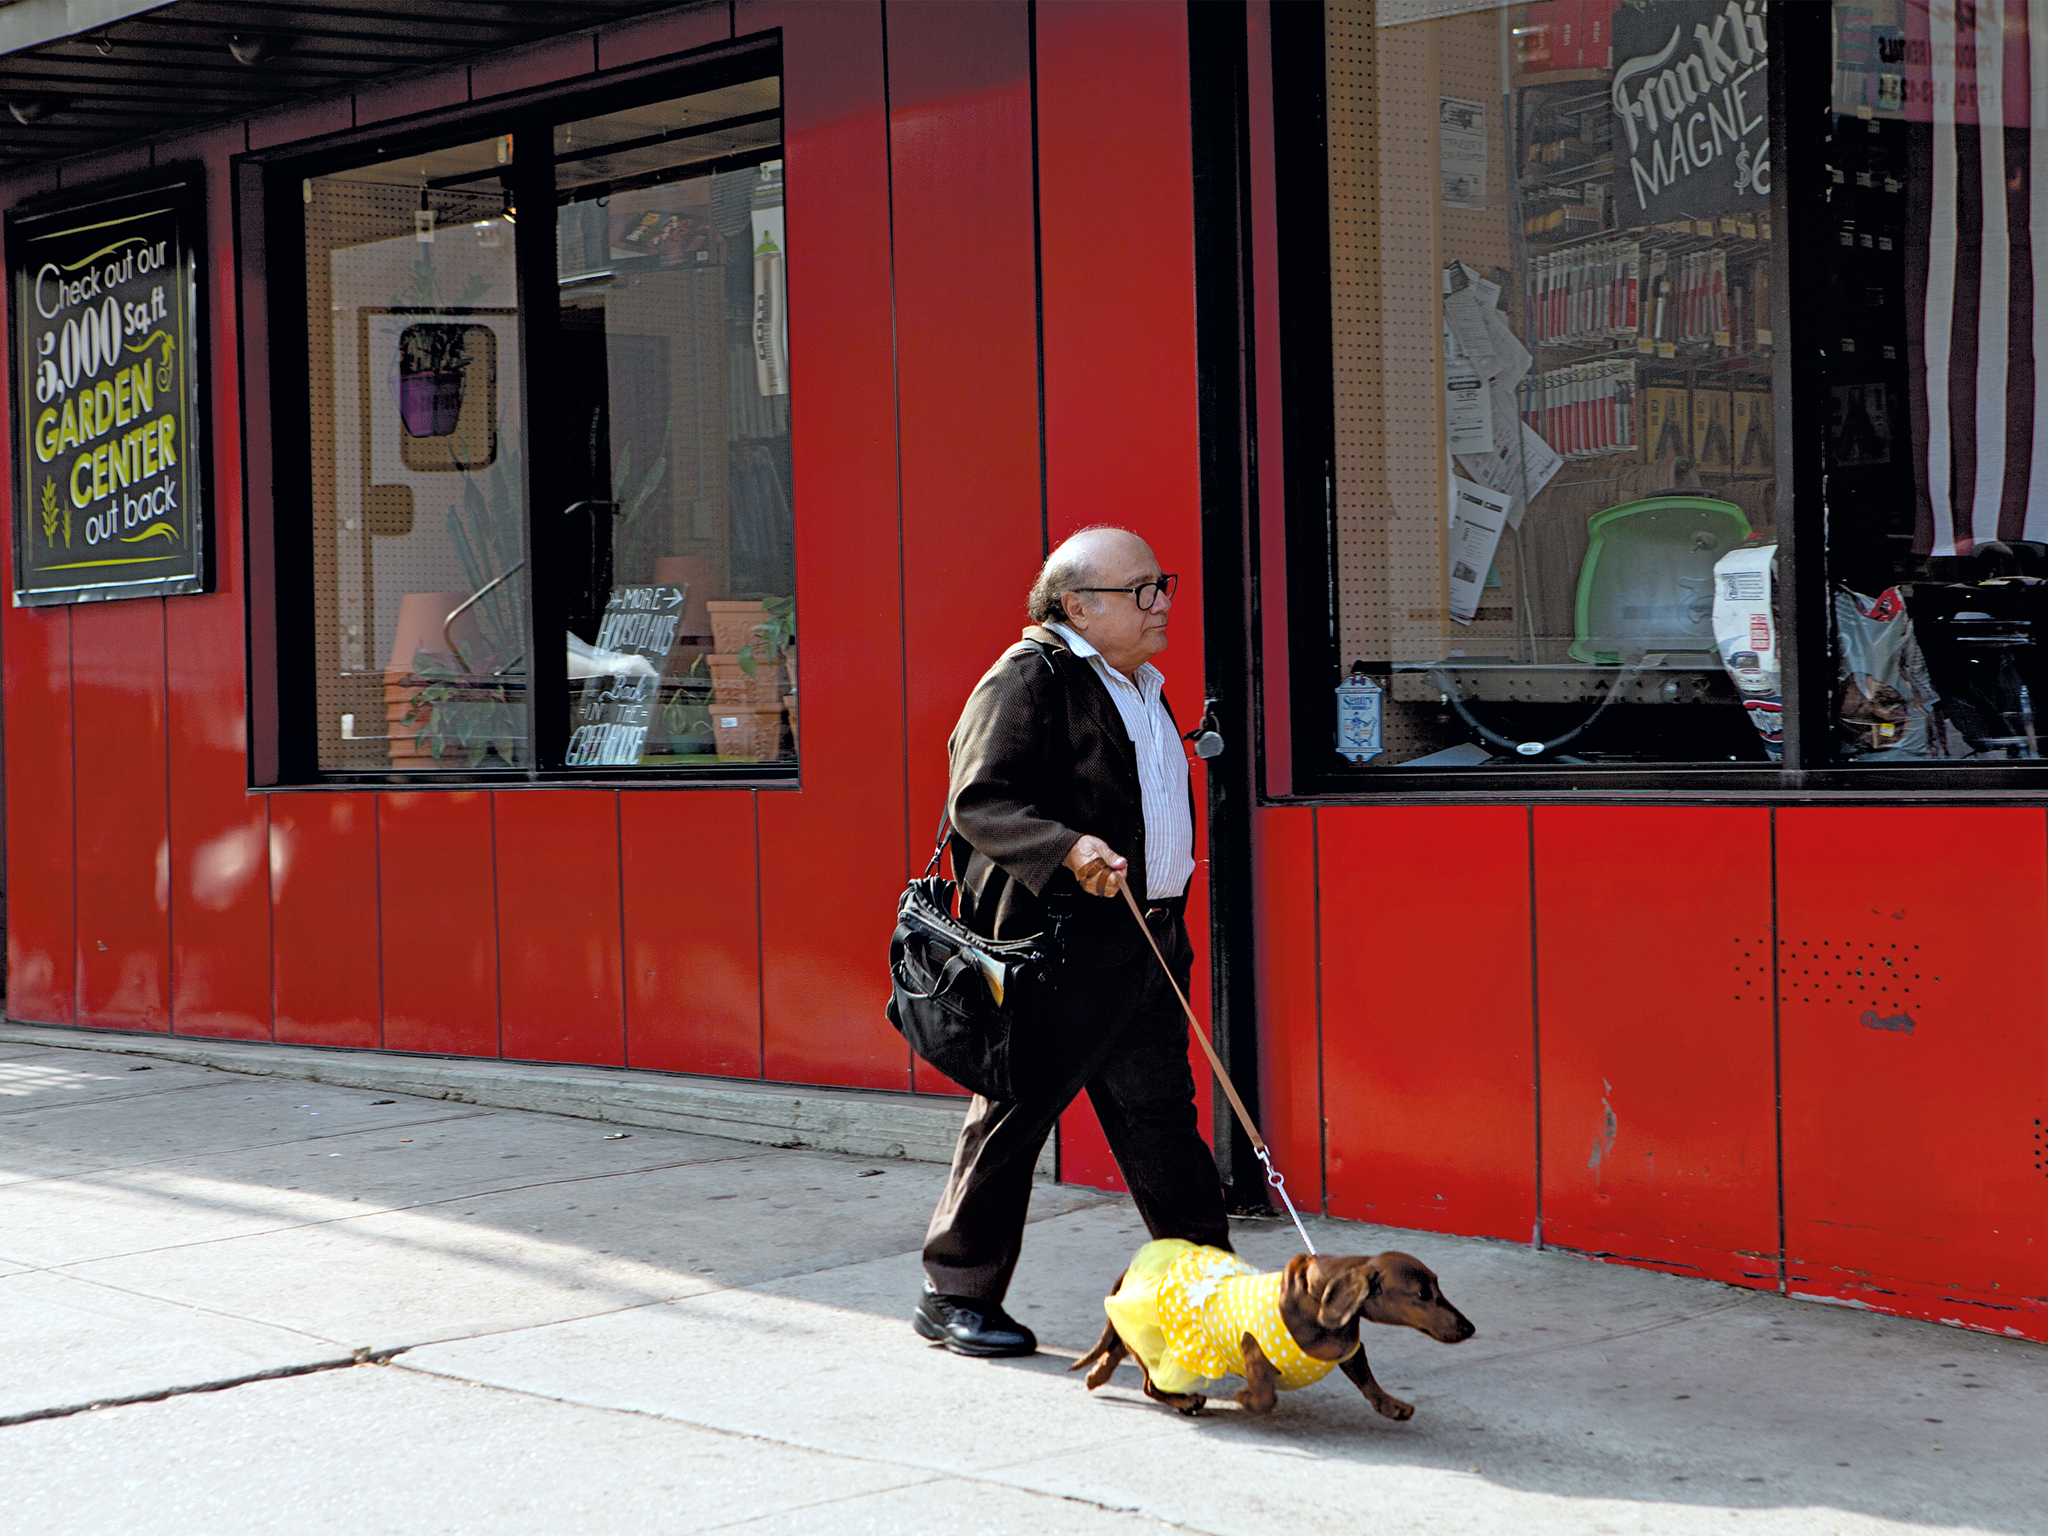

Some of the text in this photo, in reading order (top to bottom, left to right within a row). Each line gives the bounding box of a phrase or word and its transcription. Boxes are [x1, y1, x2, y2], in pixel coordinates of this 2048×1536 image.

[1612, 0, 1768, 154] Frankli
[35, 240, 168, 320] Check out our
[36, 296, 122, 404] 5,000
[35, 358, 154, 464] GARDEN
[70, 413, 178, 509] CENTER
[85, 475, 178, 547] out back
[621, 588, 666, 610] MORE
[584, 702, 643, 724] IN THE
[600, 673, 648, 703] Back
